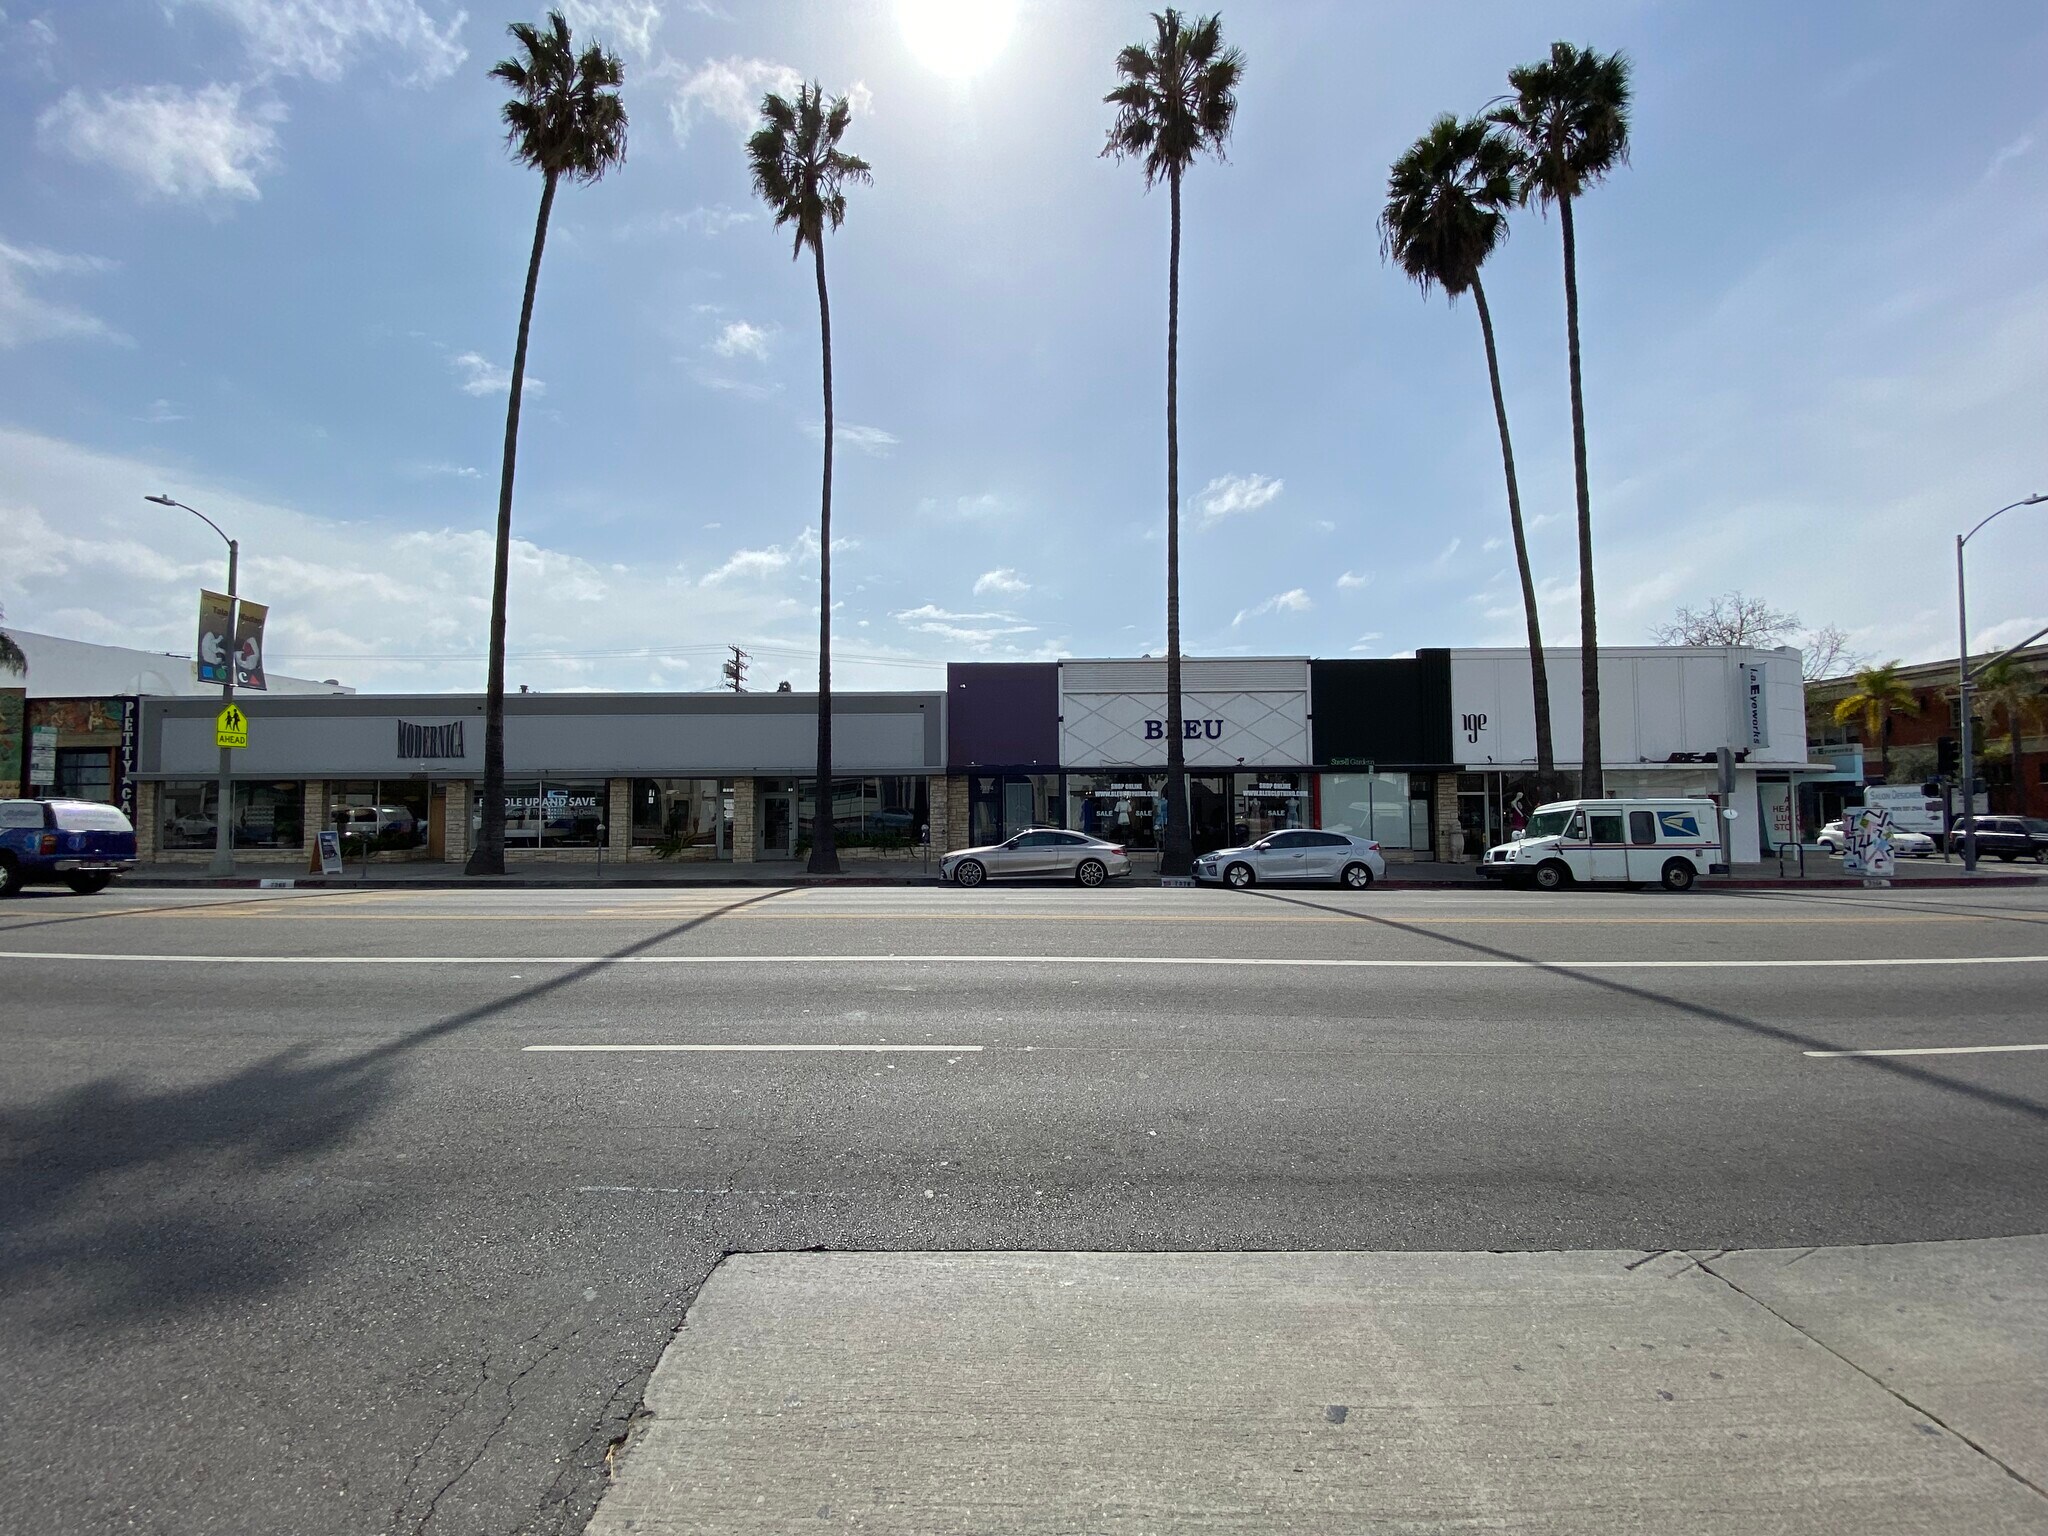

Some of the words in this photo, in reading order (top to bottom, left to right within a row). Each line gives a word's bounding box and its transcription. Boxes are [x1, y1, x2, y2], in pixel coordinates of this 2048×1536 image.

[1144, 719, 1224, 740] BEU
[219, 735, 246, 744] AHEAD
[397, 719, 465, 759] MODERNICA
[524, 797, 539, 807] UP
[541, 797, 566, 807] AND
[568, 797, 596, 807] SAVE
